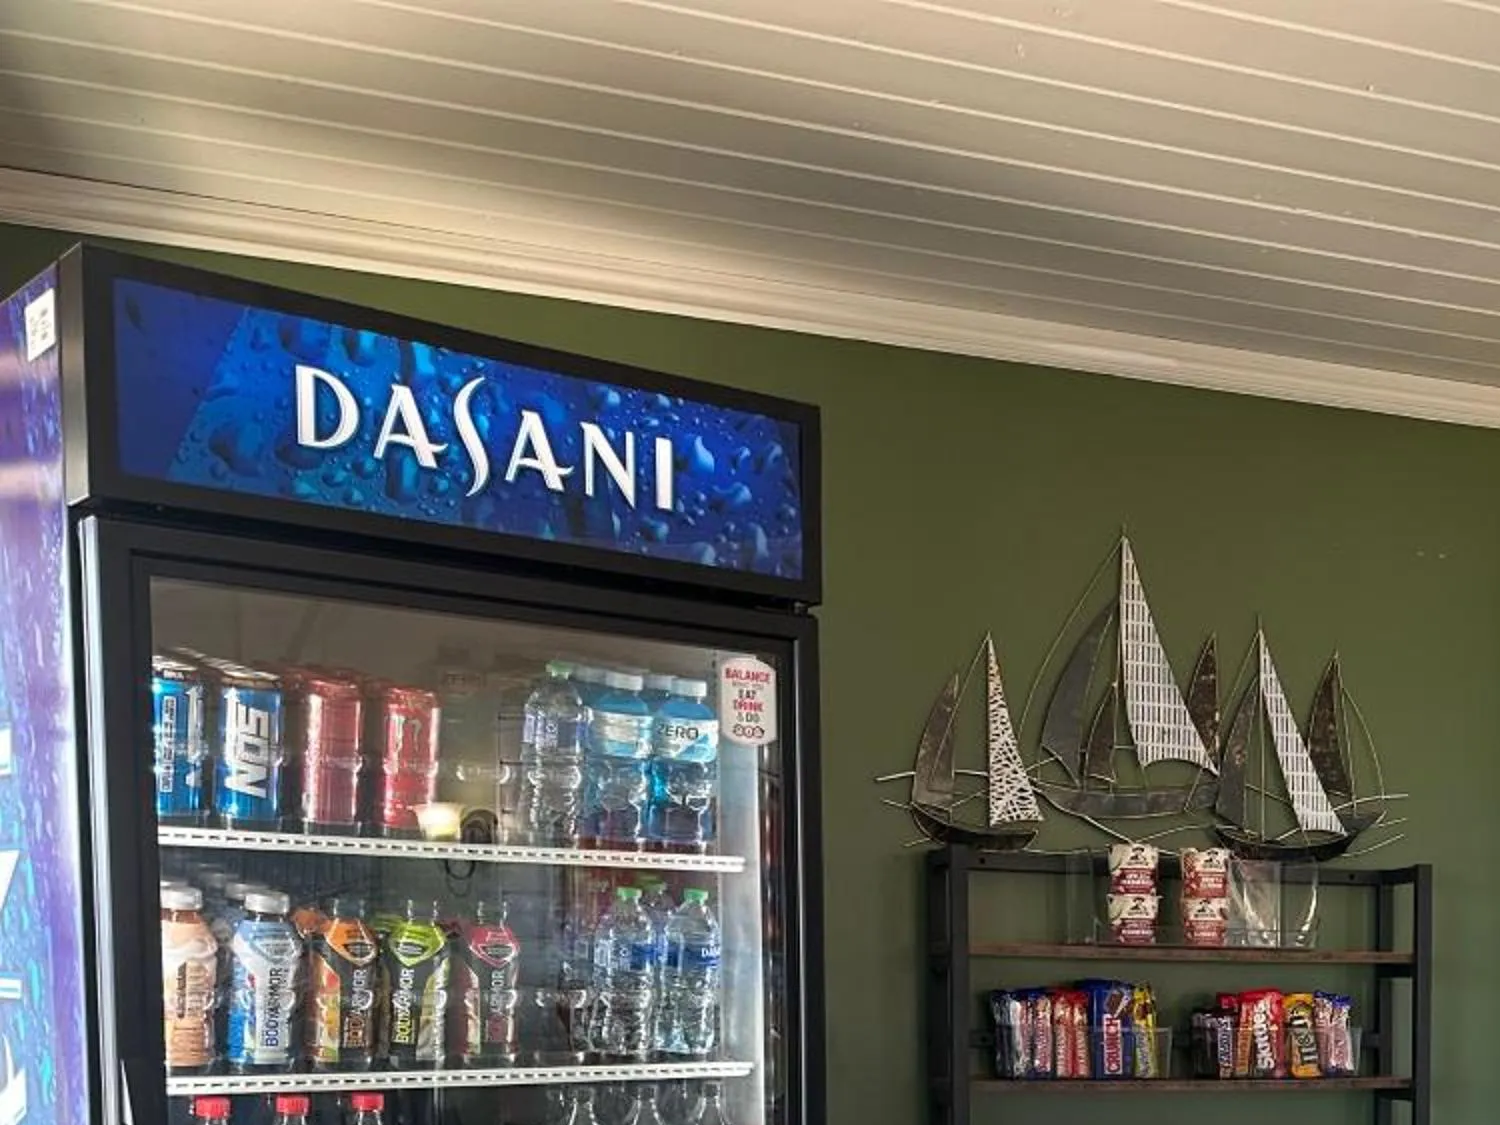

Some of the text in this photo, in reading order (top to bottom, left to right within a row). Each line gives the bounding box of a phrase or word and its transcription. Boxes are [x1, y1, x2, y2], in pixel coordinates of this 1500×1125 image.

[293, 364, 675, 512] DASANI
[222, 690, 270, 799] NOS
[656, 722, 700, 741] ZERO
